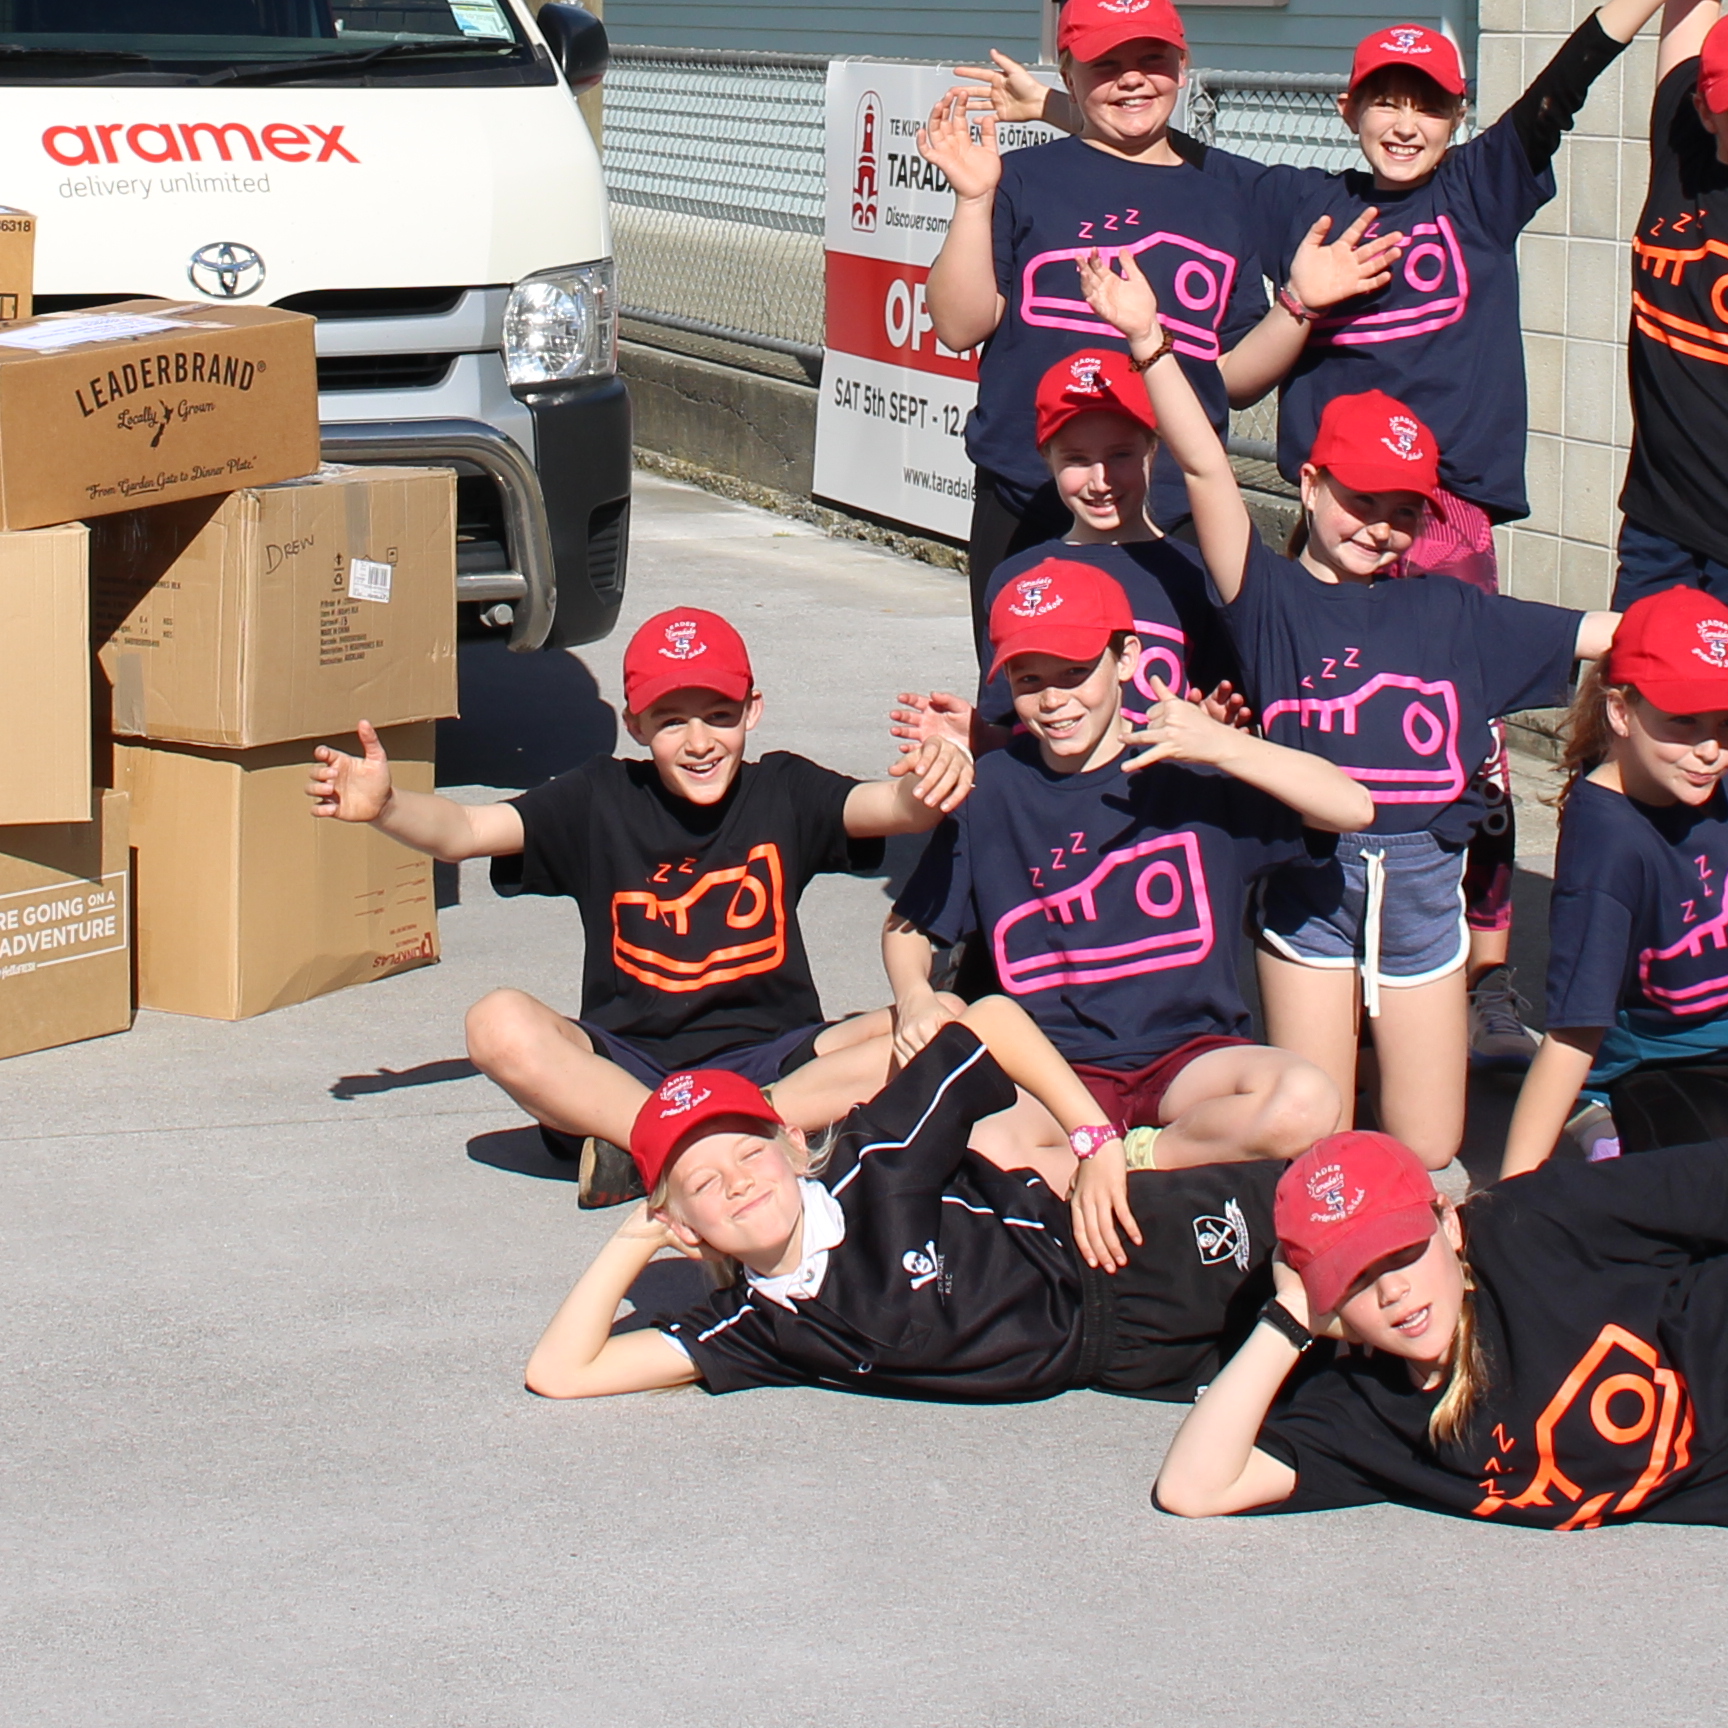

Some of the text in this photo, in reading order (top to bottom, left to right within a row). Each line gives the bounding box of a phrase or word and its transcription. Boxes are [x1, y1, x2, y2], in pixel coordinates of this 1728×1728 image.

[890, 119, 901, 136] TE
[41, 122, 362, 167] aramex
[59, 172, 271, 200] delivery unlimited
[885, 206, 926, 230] Discover
[117, 399, 216, 430] Locally Grown
[834, 377, 861, 411] SAT
[863, 386, 885, 418] 5th
[889, 391, 928, 429] SEPT
[117, 478, 155, 496] Garden
[157, 474, 179, 492] Gate
[180, 471, 189, 483] to
[191, 465, 225, 482] Dinner
[265, 534, 315, 575] DREW
[23, 897, 83, 926] GOING
[88, 892, 105, 907] ON
[106, 890, 116, 903] A
